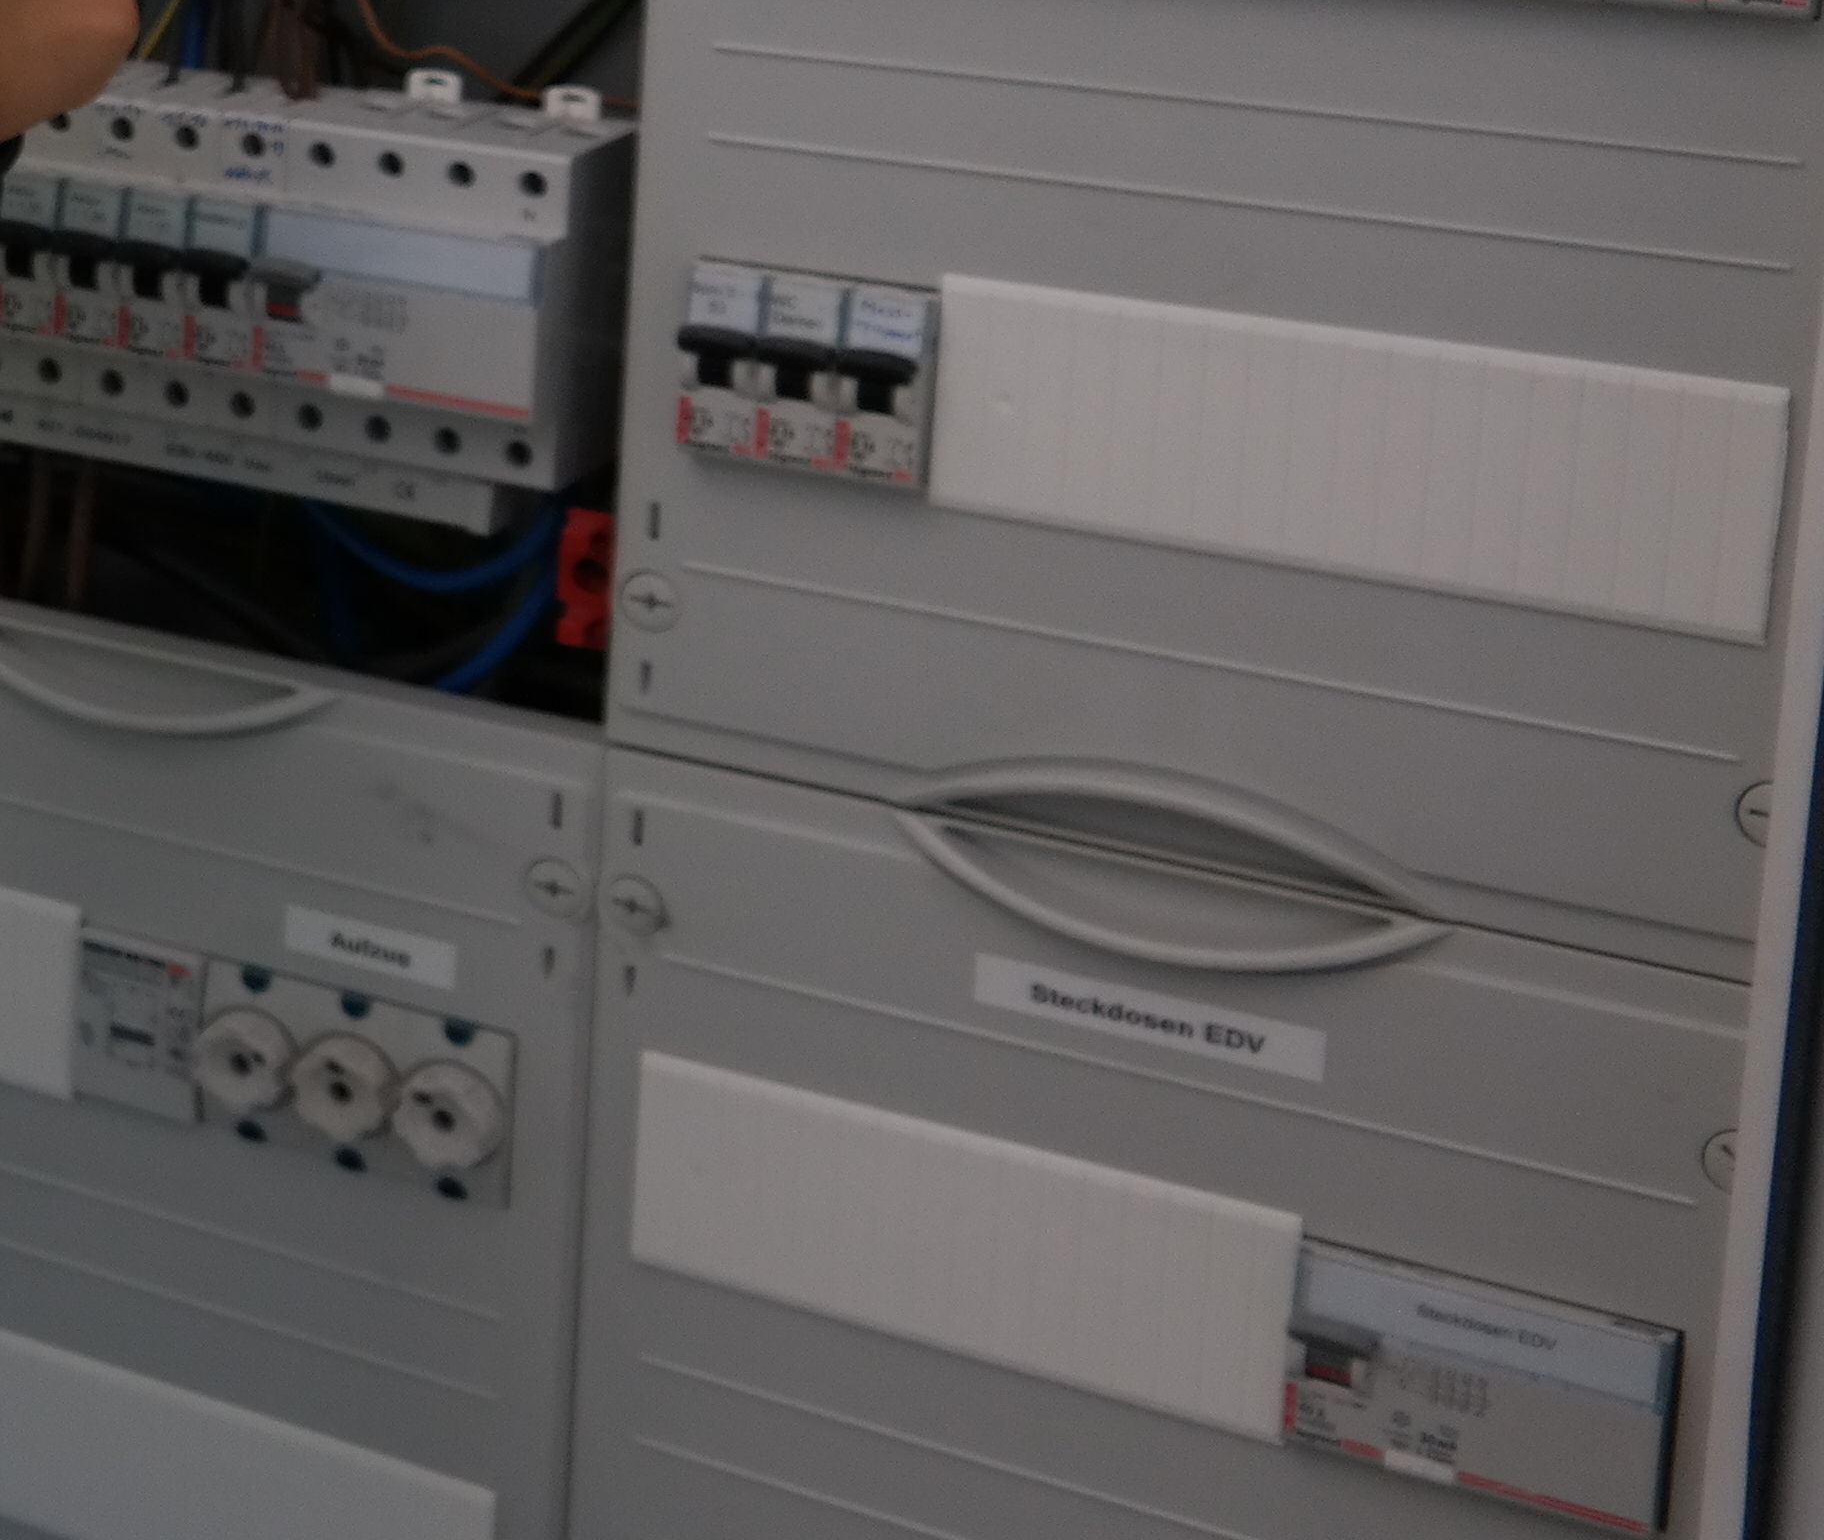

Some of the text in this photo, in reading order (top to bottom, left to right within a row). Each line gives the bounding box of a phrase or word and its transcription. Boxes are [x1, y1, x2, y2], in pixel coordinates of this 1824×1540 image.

[330, 931, 411, 969] Aufzug
[1029, 981, 1266, 1055] Steckdosen EDV
